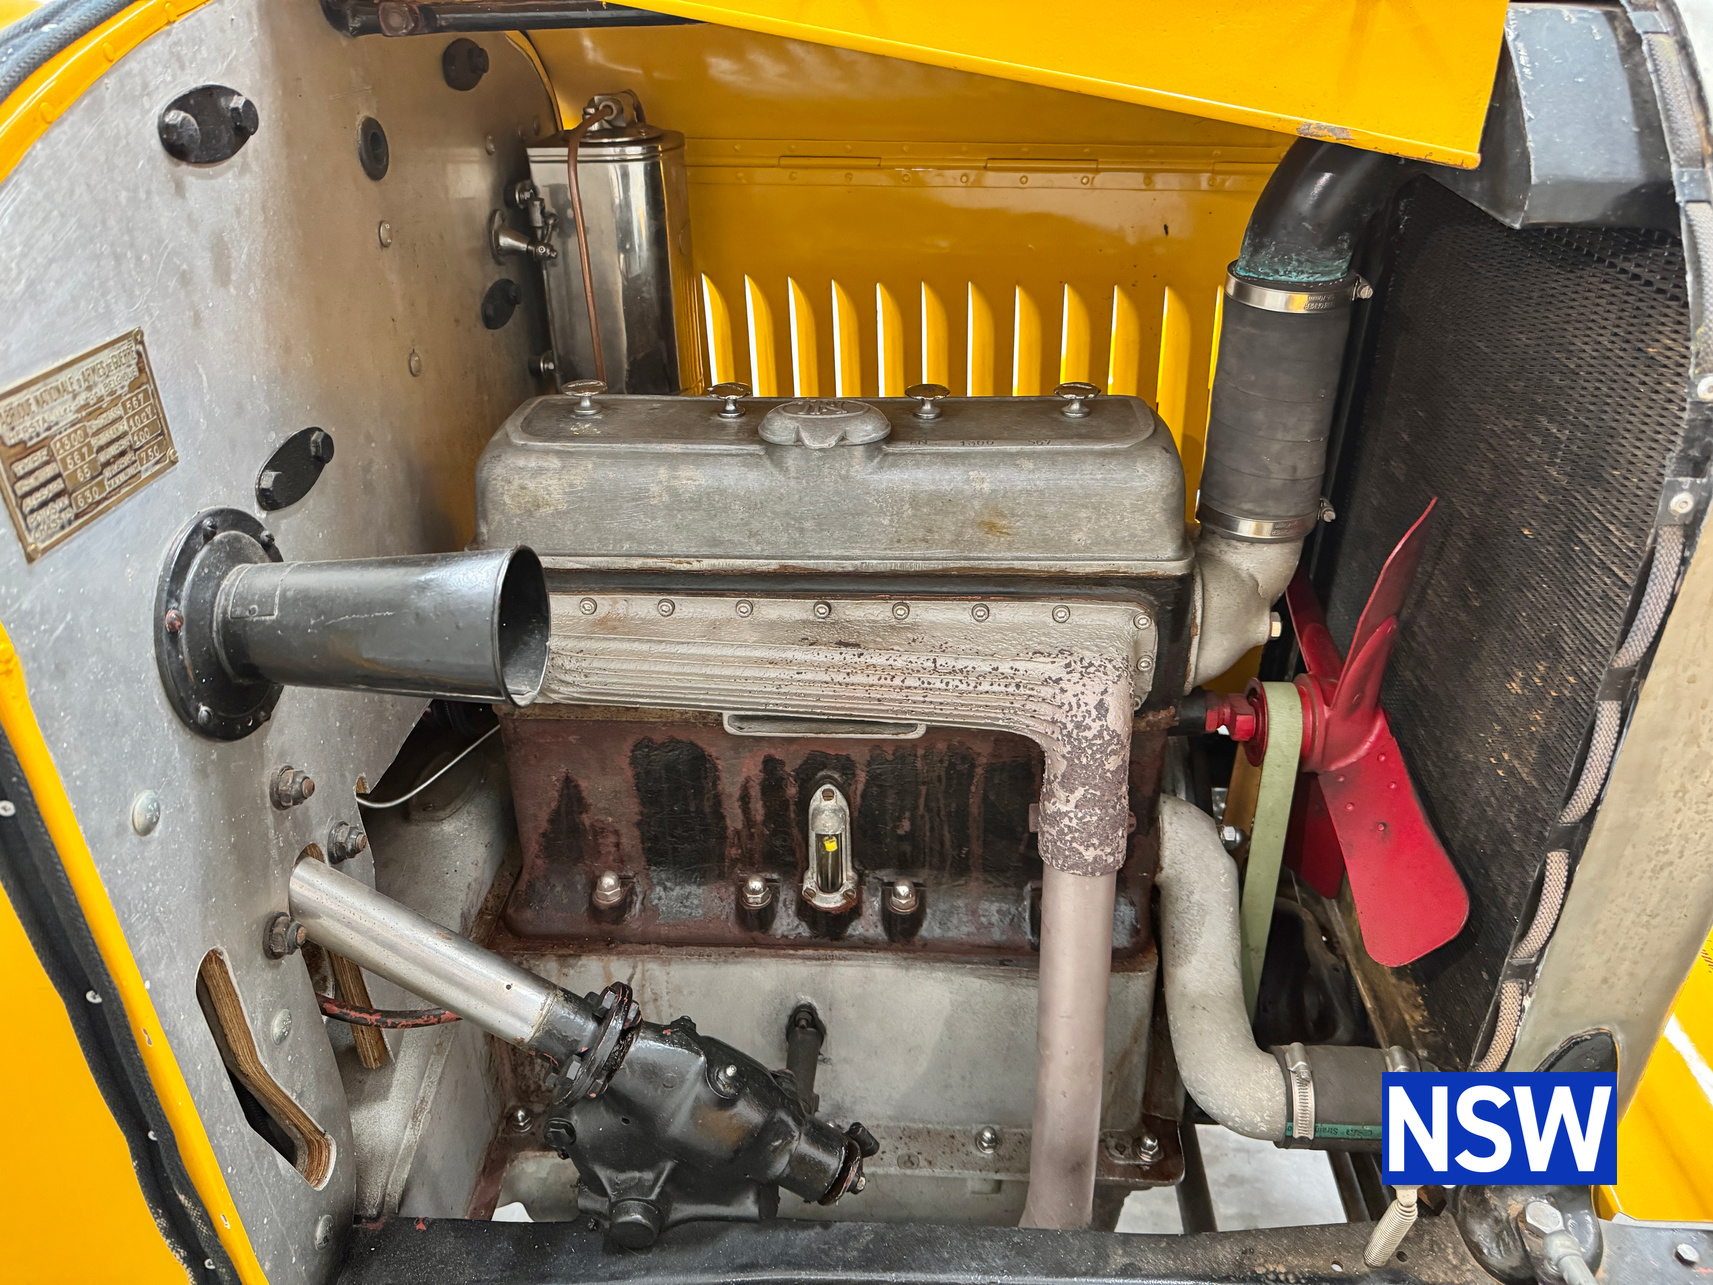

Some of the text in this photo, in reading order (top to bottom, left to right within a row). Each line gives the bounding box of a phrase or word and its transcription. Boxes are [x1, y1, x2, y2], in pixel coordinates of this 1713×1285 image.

[32, 376, 76, 410] NATIONALE
[109, 345, 136, 370] GUERRE
[54, 427, 85, 454] 1300
[132, 426, 150, 446] 100
[140, 443, 160, 465] 750
[75, 463, 91, 482] 65
[76, 484, 99, 508] 630
